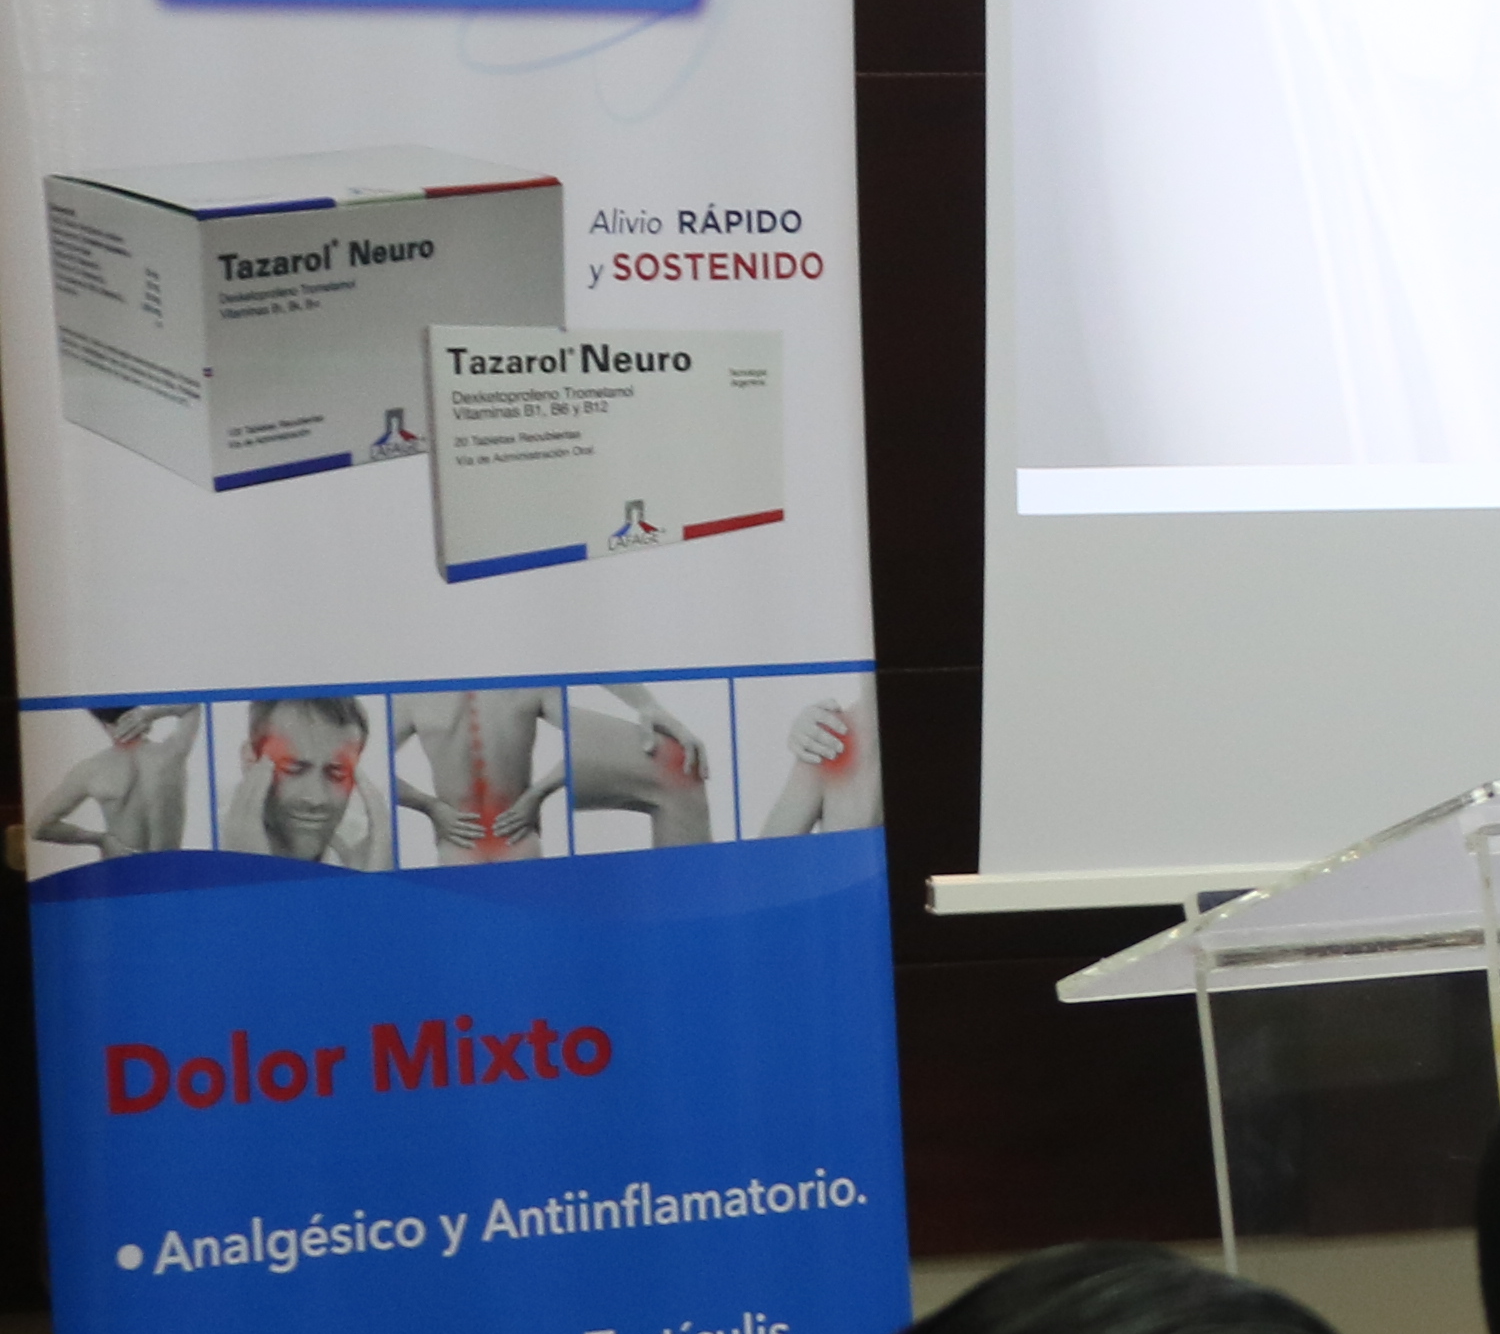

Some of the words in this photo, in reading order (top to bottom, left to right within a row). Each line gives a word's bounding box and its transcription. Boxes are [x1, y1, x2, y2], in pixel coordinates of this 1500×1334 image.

[589, 208, 663, 237] Alivio
[678, 203, 802, 236] RÁPIDO
[349, 239, 435, 267] Neuro
[588, 265, 603, 288] y
[613, 252, 824, 282] SOSTENIDO
[580, 344, 692, 373] Neuro
[453, 406, 521, 419] Vitaminas
[583, 400, 609, 414] B12
[104, 1031, 345, 1115] Dolor
[371, 1014, 612, 1093] Mixto
[153, 1207, 427, 1276] Analgésico
[440, 1211, 468, 1256] y
[482, 1167, 868, 1243] Antiinflamatorio.
